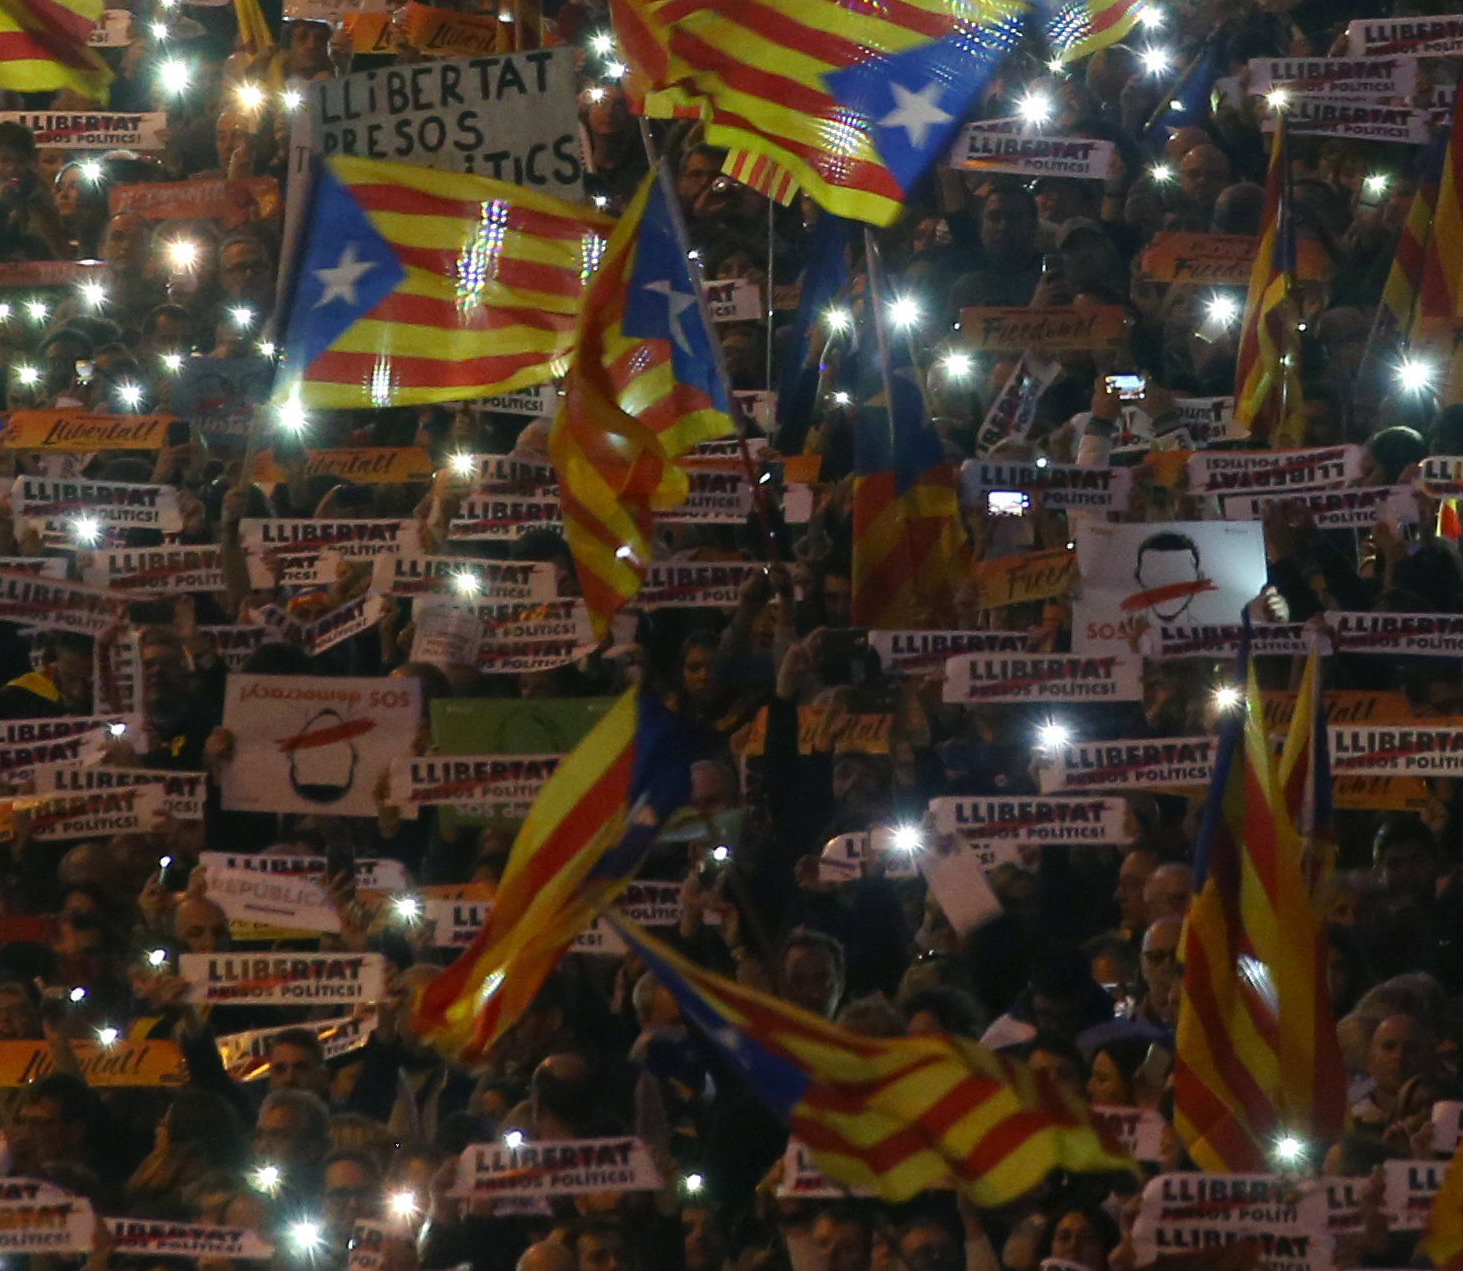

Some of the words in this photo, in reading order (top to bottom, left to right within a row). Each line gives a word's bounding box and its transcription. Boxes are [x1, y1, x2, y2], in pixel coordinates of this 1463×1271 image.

[1272, 60, 1396, 79] LLIBERTAT
[23, 482, 159, 508] LLIBERTAT
[262, 524, 399, 542] LLIBERTAT
[893, 634, 1029, 653] LLIBERTAT
[970, 659, 1116, 679] LLIBERTAT
[1066, 744, 1213, 769] LLIBERTAT
[410, 761, 558, 782] LLIBERTAT
[956, 802, 1104, 823] LLIBERTAT
[208, 958, 363, 982] LLIBERTAT
